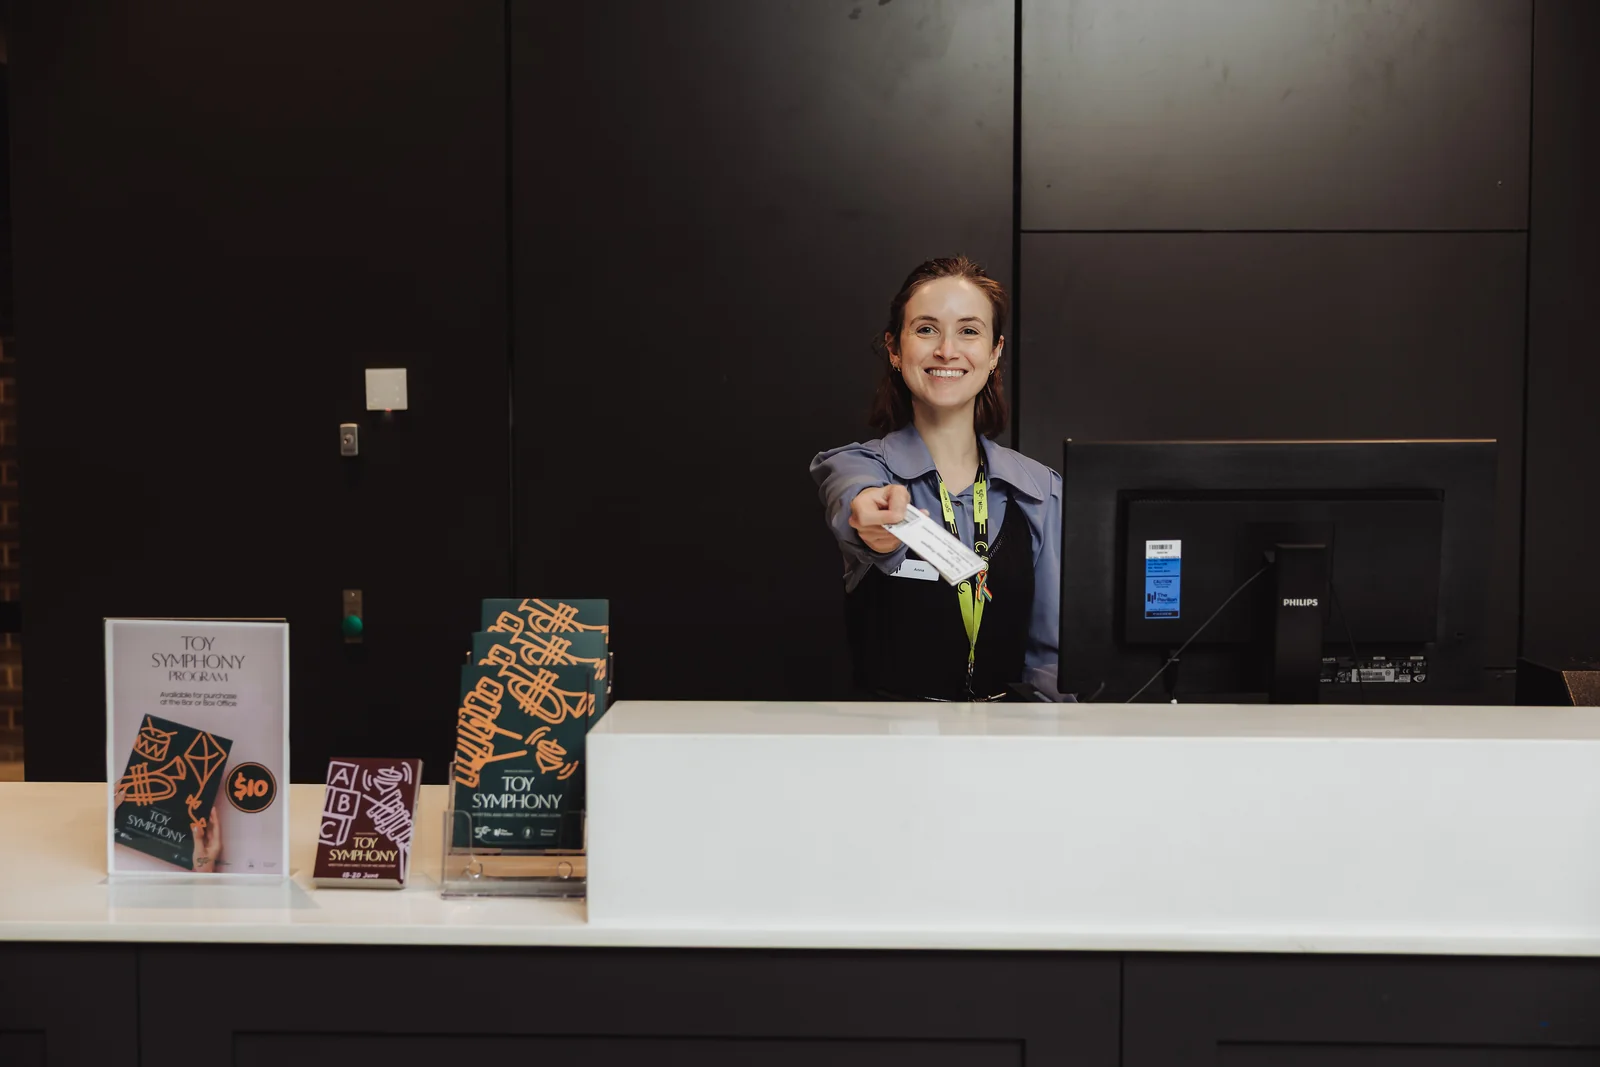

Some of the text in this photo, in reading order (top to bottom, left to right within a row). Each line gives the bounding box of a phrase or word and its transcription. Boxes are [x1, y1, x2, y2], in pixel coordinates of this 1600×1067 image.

[1283, 598, 1319, 607] PHILIPS
[180, 635, 216, 652] TOY
[151, 652, 246, 670] SYMPHONY
[168, 670, 229, 682] PROGRAM
[160, 691, 238, 701] Available for purchase
[216, 699, 238, 707] Office
[233, 771, 269, 801] $10
[501, 776, 535, 792] TOY
[471, 793, 563, 810] SYMPHONY
[150, 809, 172, 826] TOY
[126, 814, 187, 843] SYMPHONY
[352, 836, 379, 849] TOY
[328, 848, 398, 862] SYMPHONY
